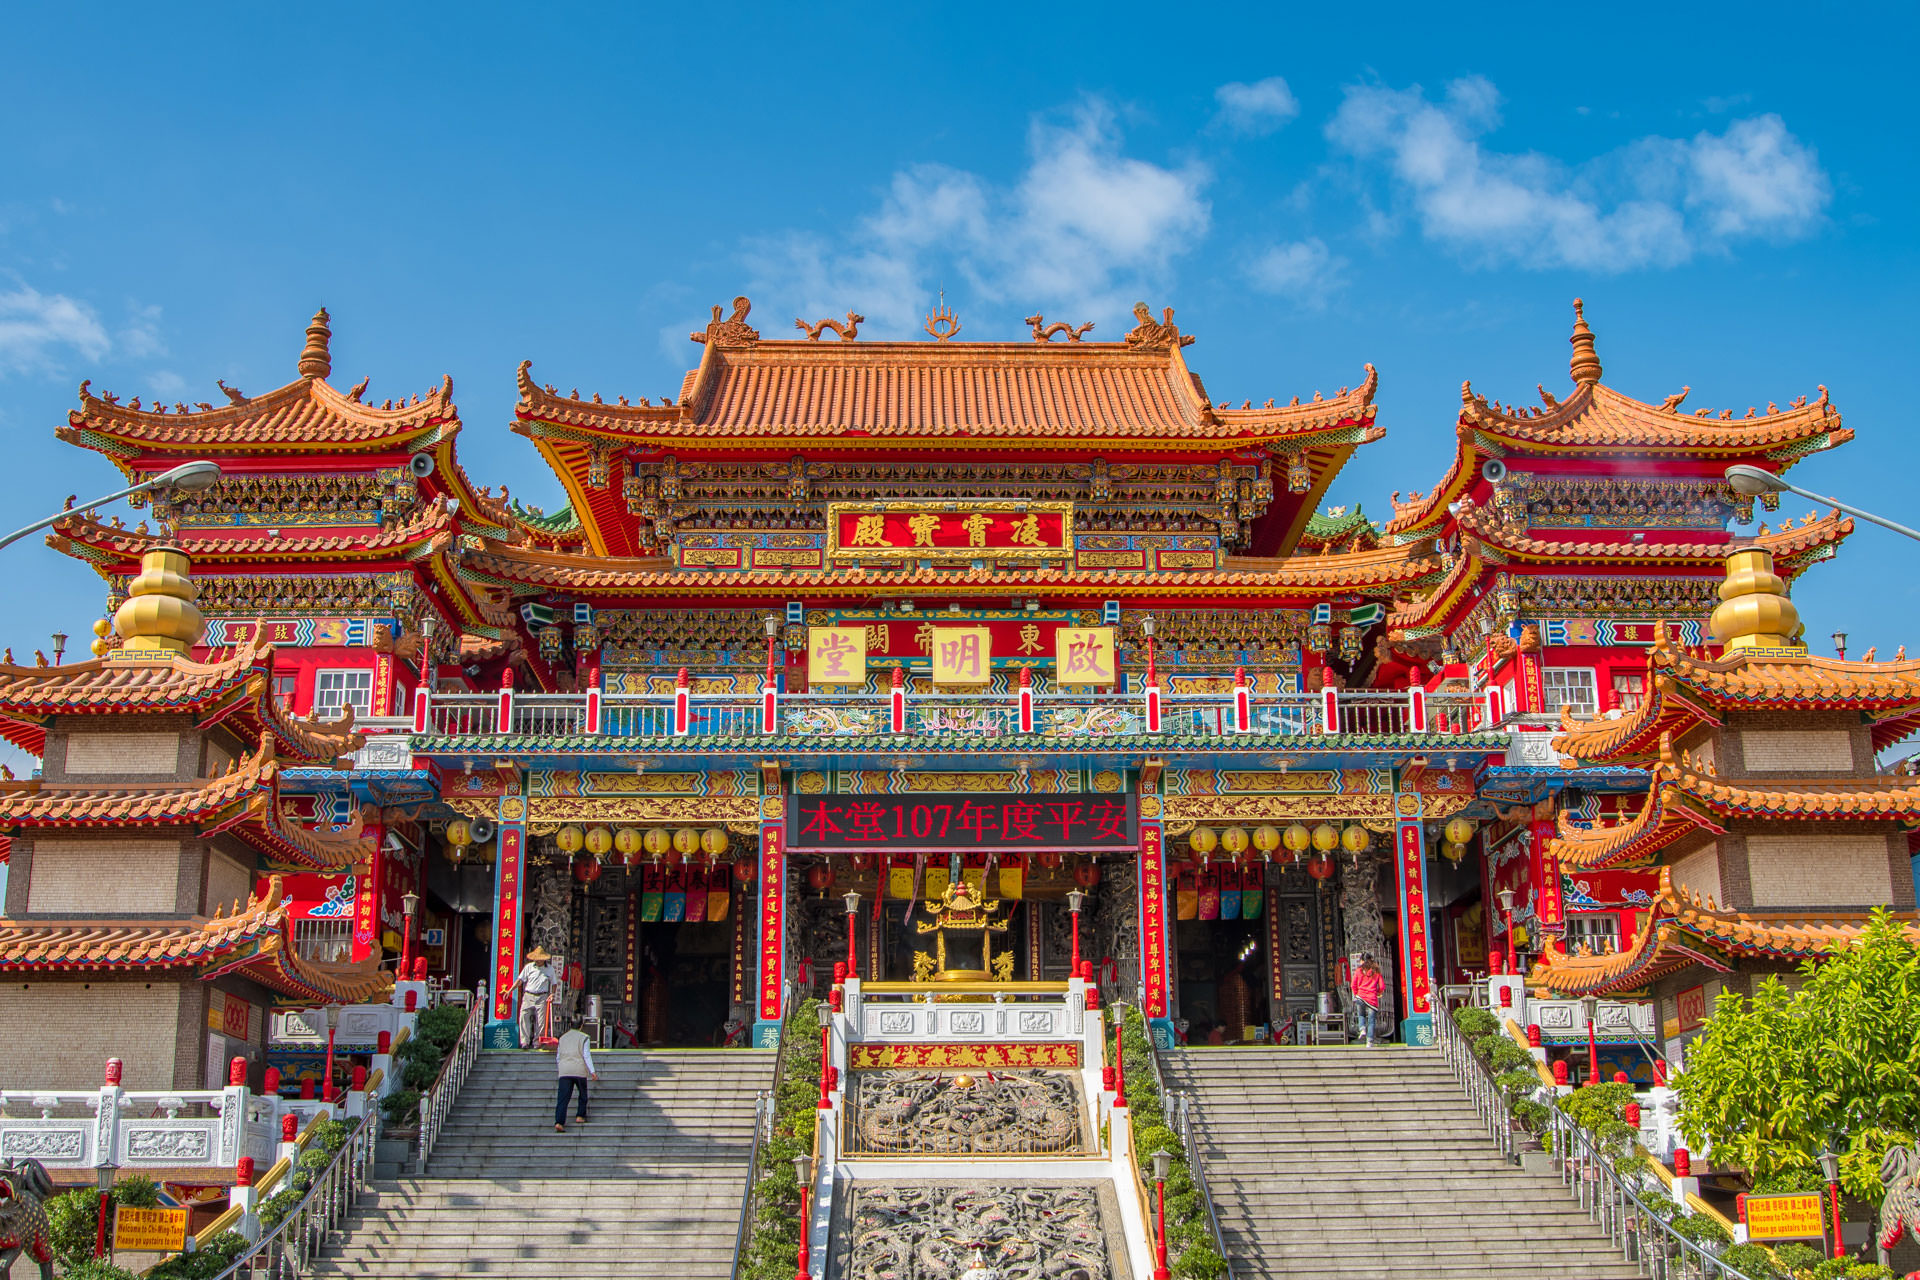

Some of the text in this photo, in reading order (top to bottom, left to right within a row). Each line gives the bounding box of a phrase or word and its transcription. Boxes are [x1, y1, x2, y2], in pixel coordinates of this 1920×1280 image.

[851, 513, 1048, 547] 凌霄寶殿
[865, 622, 1044, 656] 東帝闕
[800, 799, 1128, 842] 本堂107年度平安
[1751, 1213, 1773, 1222] Welcome
[1781, 1211, 1819, 1222] Chi-Ming-Tang
[118, 1224, 141, 1233] Welcome
[149, 1224, 183, 1236] Chi-Ming-Tang
[1752, 1225, 1769, 1233] Please
[1770, 1226, 1777, 1234] go
[1778, 1224, 1800, 1233] upstairs
[1809, 1223, 1820, 1231] visit
[117, 1235, 134, 1245] Please
[135, 1238, 142, 1246] go
[143, 1236, 163, 1246] upstairs
[171, 1237, 182, 1246] visit
